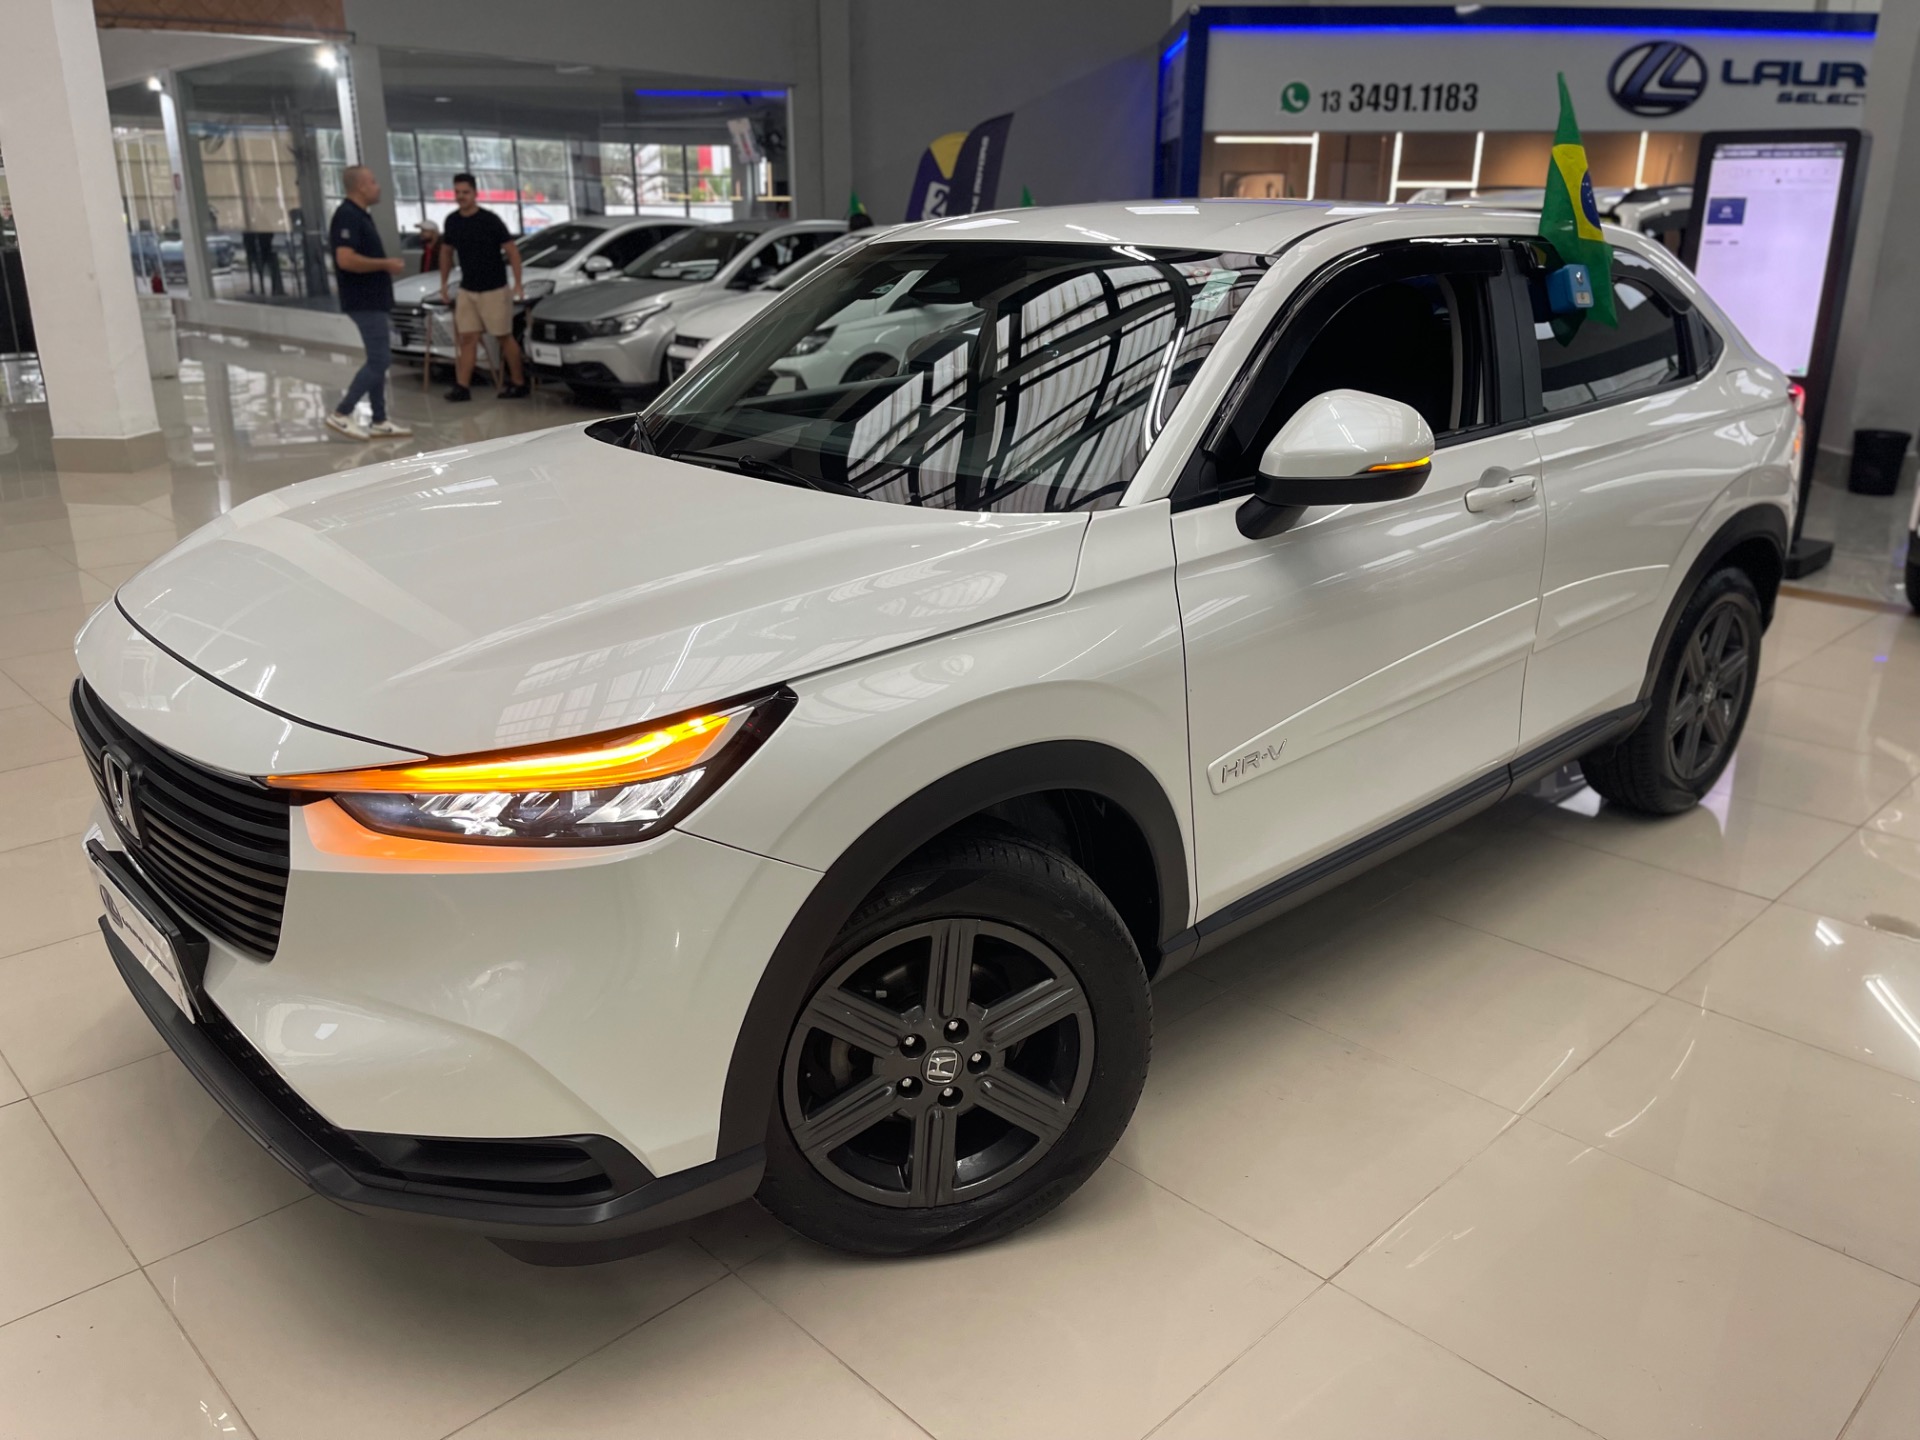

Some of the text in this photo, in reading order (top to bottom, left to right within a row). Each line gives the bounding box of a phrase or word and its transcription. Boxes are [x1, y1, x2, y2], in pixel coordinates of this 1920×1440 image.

[1320, 83, 1478, 113] 13 3491.1183
[1221, 739, 1287, 784] HR-V
